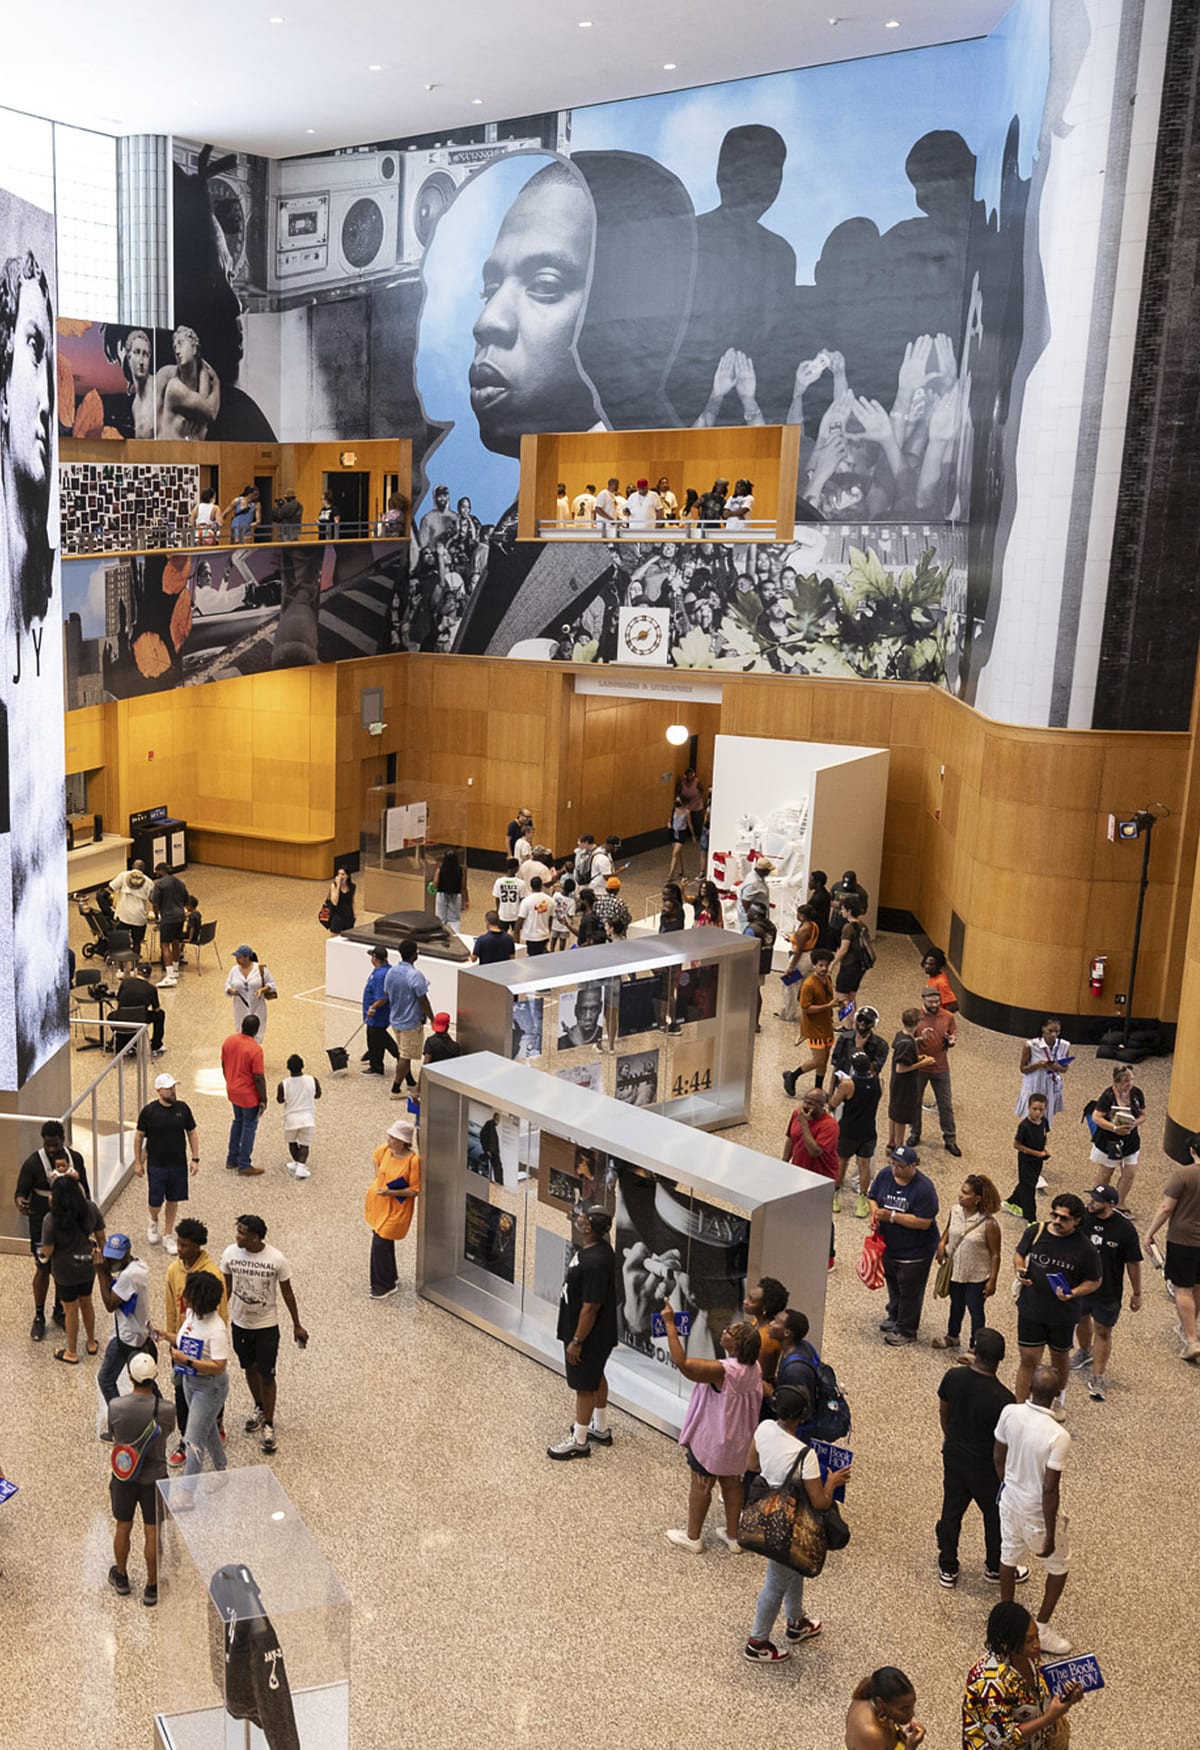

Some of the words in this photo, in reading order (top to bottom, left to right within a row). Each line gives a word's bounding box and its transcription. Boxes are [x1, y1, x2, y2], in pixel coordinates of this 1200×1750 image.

[500, 890, 517, 903] 23
[672, 1068, 712, 1097] 4:44
[230, 1259, 275, 1270] EMOTIONAL
[812, 1442, 828, 1455] The
[829, 1447, 851, 1461] Book
[1048, 1668, 1068, 1682] The
[1068, 1659, 1097, 1676] Book
[1052, 1680, 1063, 1695] of
